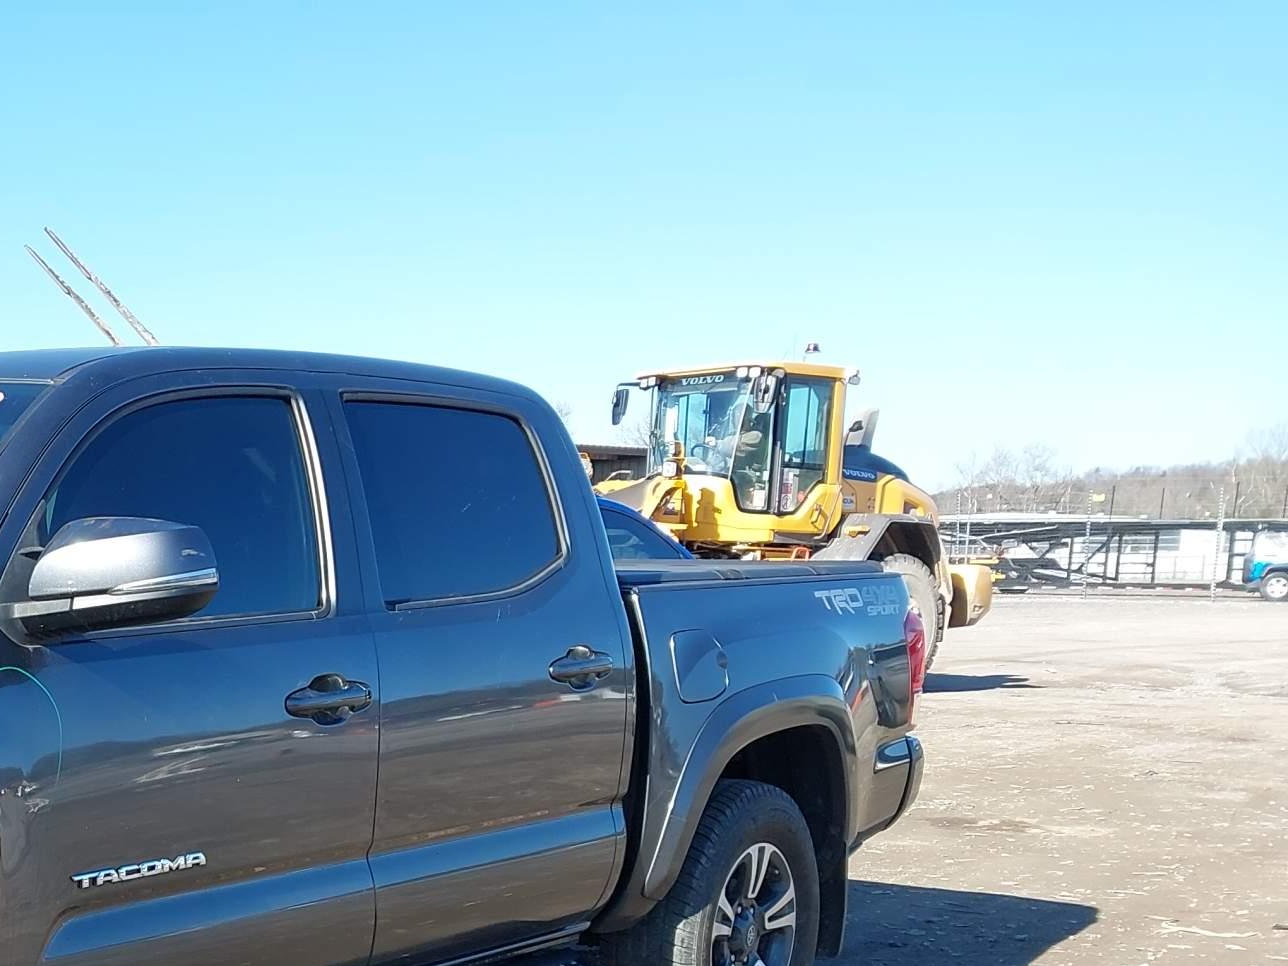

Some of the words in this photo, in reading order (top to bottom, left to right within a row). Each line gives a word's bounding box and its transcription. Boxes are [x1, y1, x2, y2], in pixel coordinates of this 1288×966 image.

[681, 374, 725, 386] VOLVO
[814, 587, 864, 616] TRD
[867, 603, 900, 617] SPORT
[70, 851, 208, 889] TACOMA
